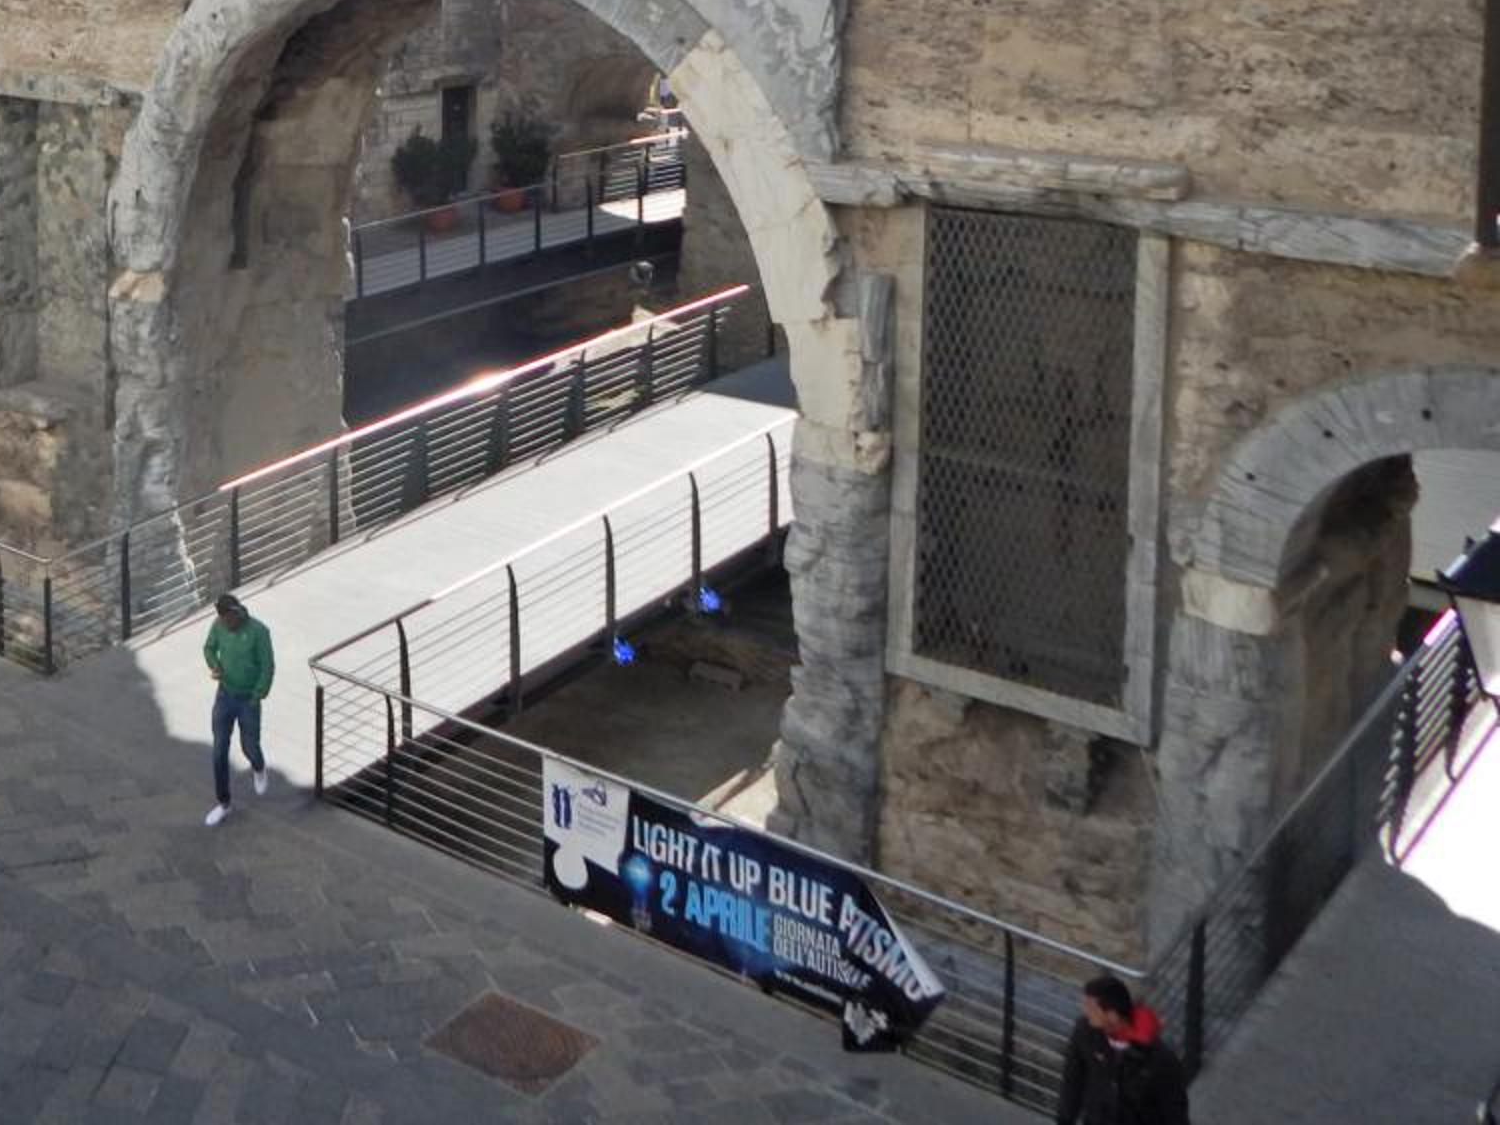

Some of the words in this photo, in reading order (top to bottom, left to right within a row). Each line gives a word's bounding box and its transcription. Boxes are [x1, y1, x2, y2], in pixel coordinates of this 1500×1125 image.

[633, 814, 698, 874] LIGHT
[700, 842, 721, 882] IT
[727, 850, 761, 895] UP
[767, 865, 834, 927] BLUE
[659, 869, 677, 916] 2
[684, 879, 771, 954] APRILE
[773, 913, 842, 958] GIORNATA
